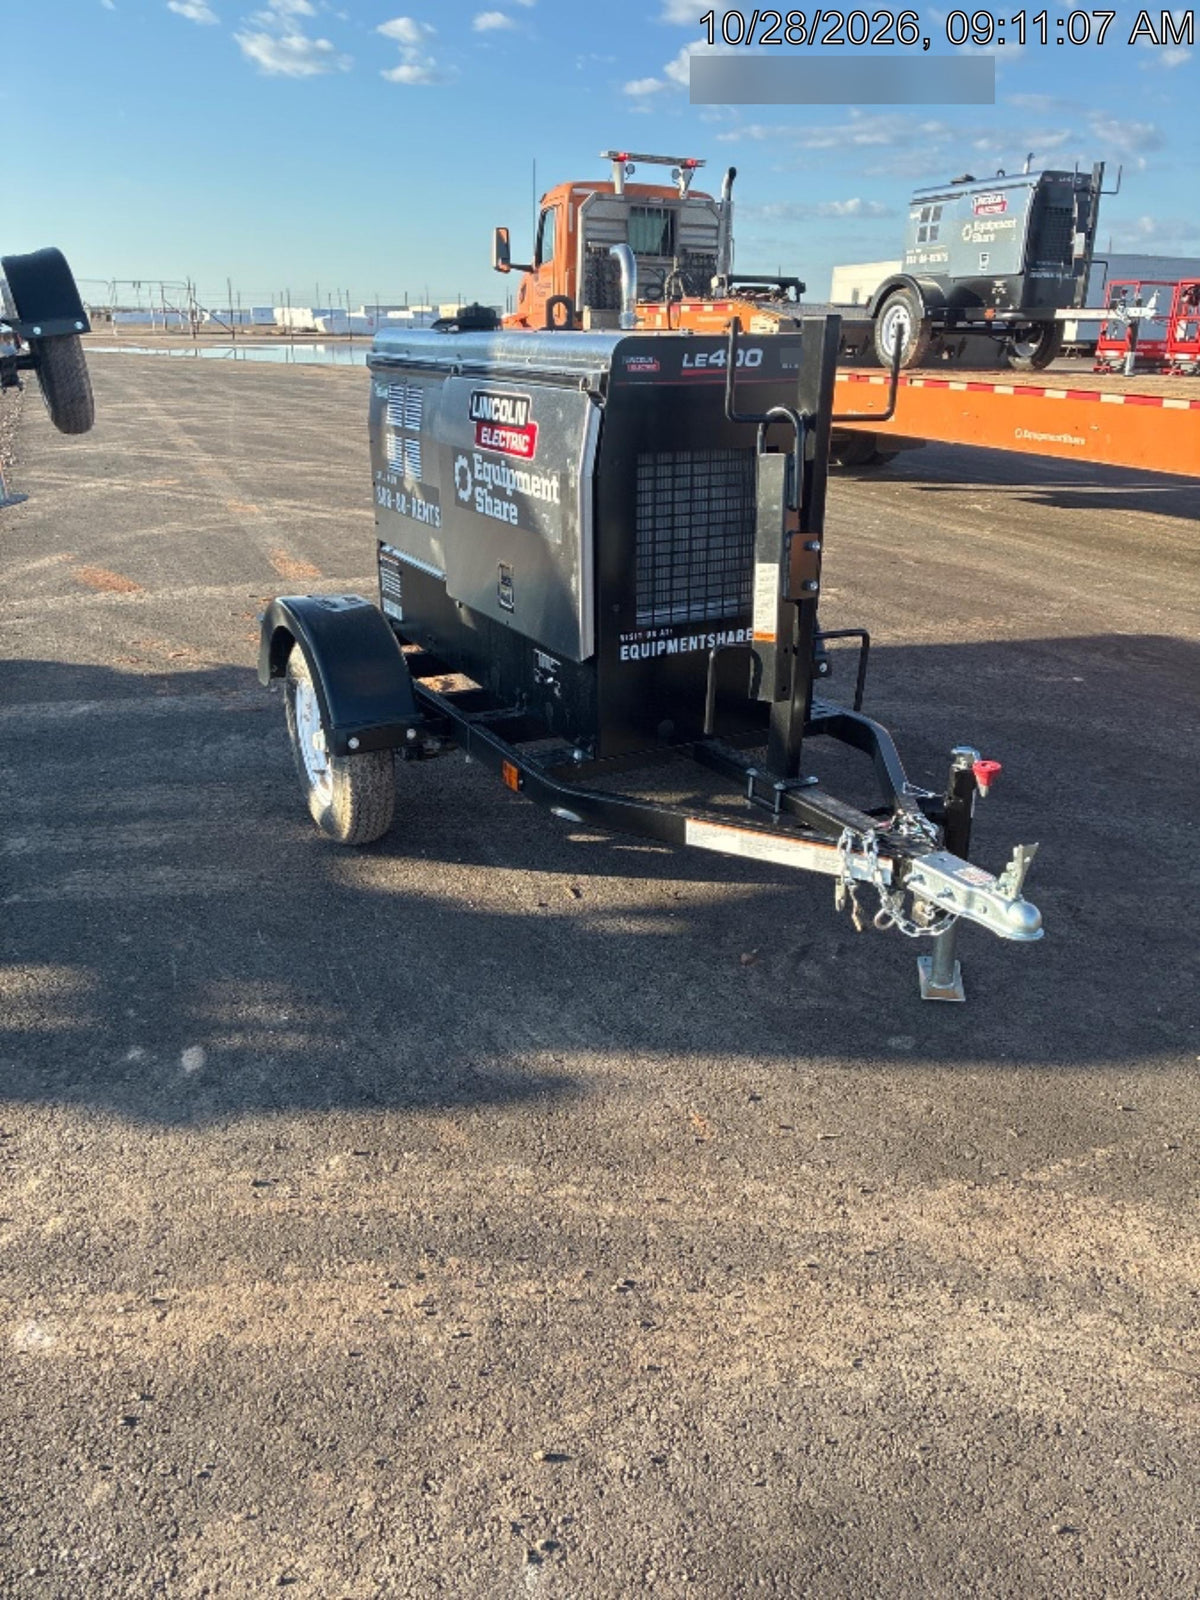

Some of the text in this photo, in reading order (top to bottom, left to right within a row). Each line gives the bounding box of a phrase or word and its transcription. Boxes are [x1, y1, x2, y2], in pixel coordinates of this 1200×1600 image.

[471, 395, 528, 426] LINCOLN
[480, 426, 531, 453] ELECTRIC
[472, 453, 561, 504] Equipment
[474, 486, 518, 525] Share
